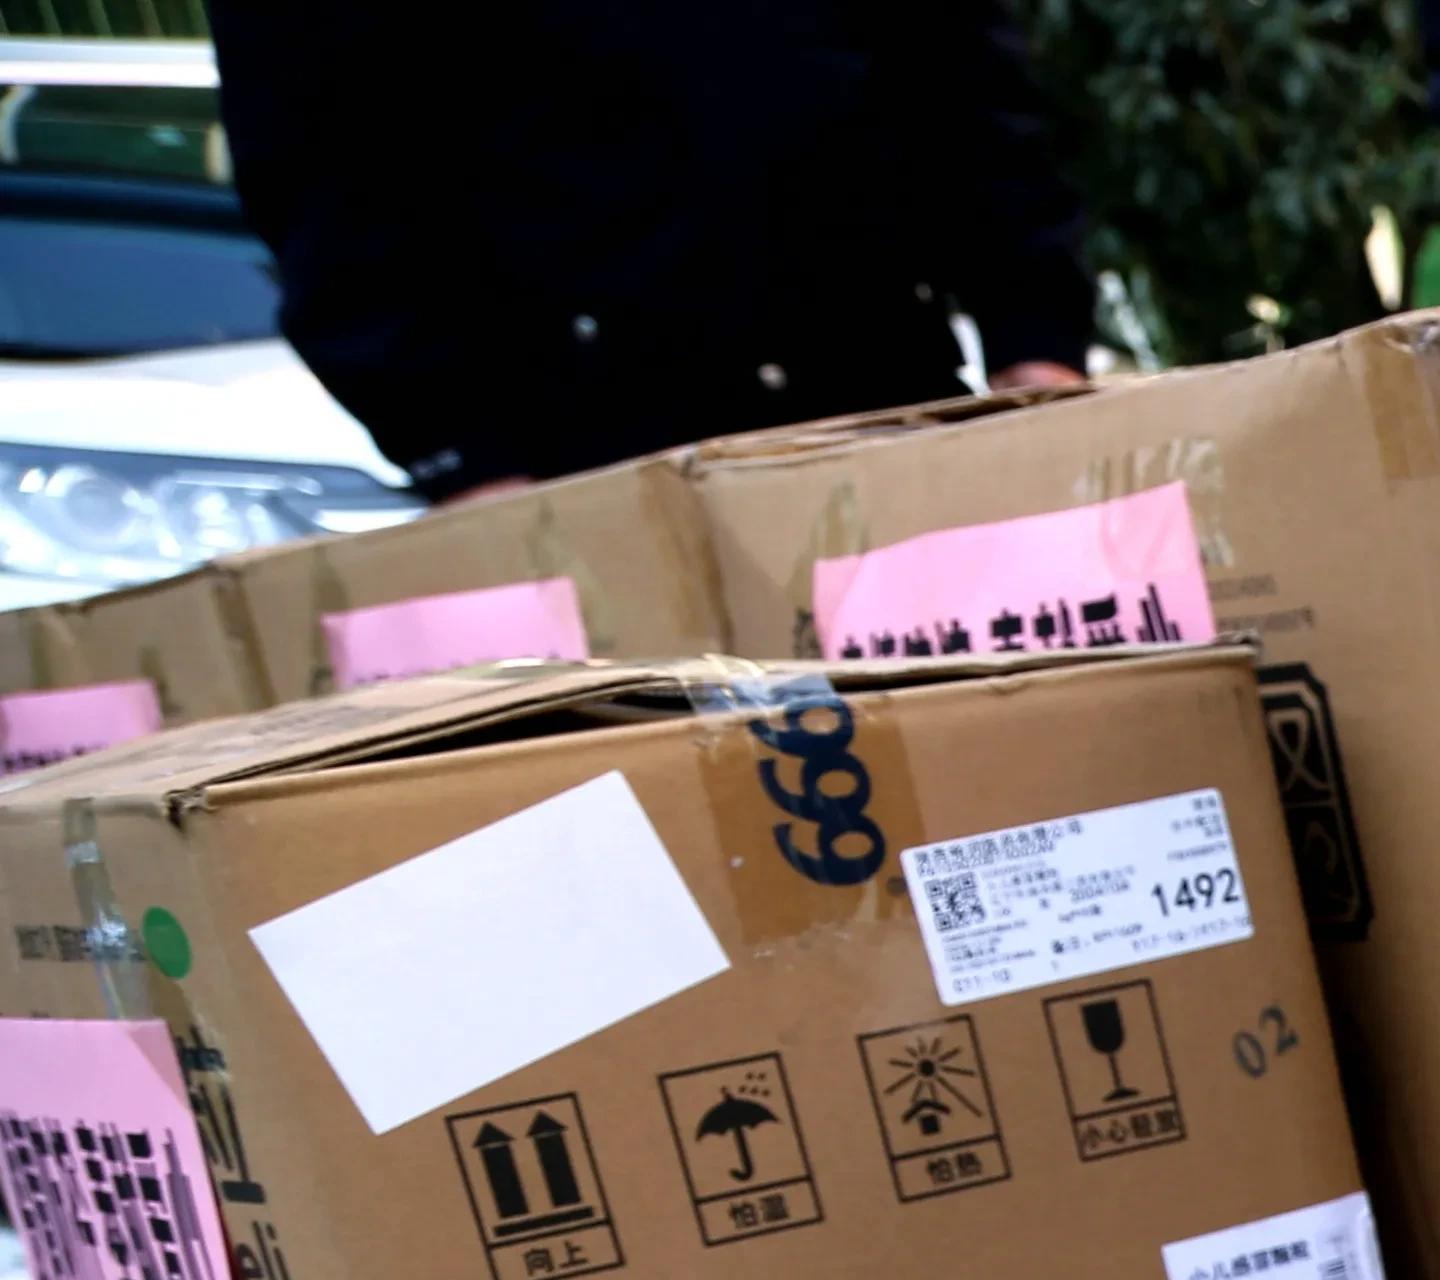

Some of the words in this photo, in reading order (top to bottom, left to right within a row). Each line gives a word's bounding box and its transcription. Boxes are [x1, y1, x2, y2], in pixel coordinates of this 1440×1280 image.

[1151, 867, 1240, 917] 1492
[1082, 1111, 1180, 1152] 小心轻放
[925, 1151, 985, 1187] 怕热
[726, 1193, 792, 1231] 怕湿
[523, 1240, 590, 1277] 向上
